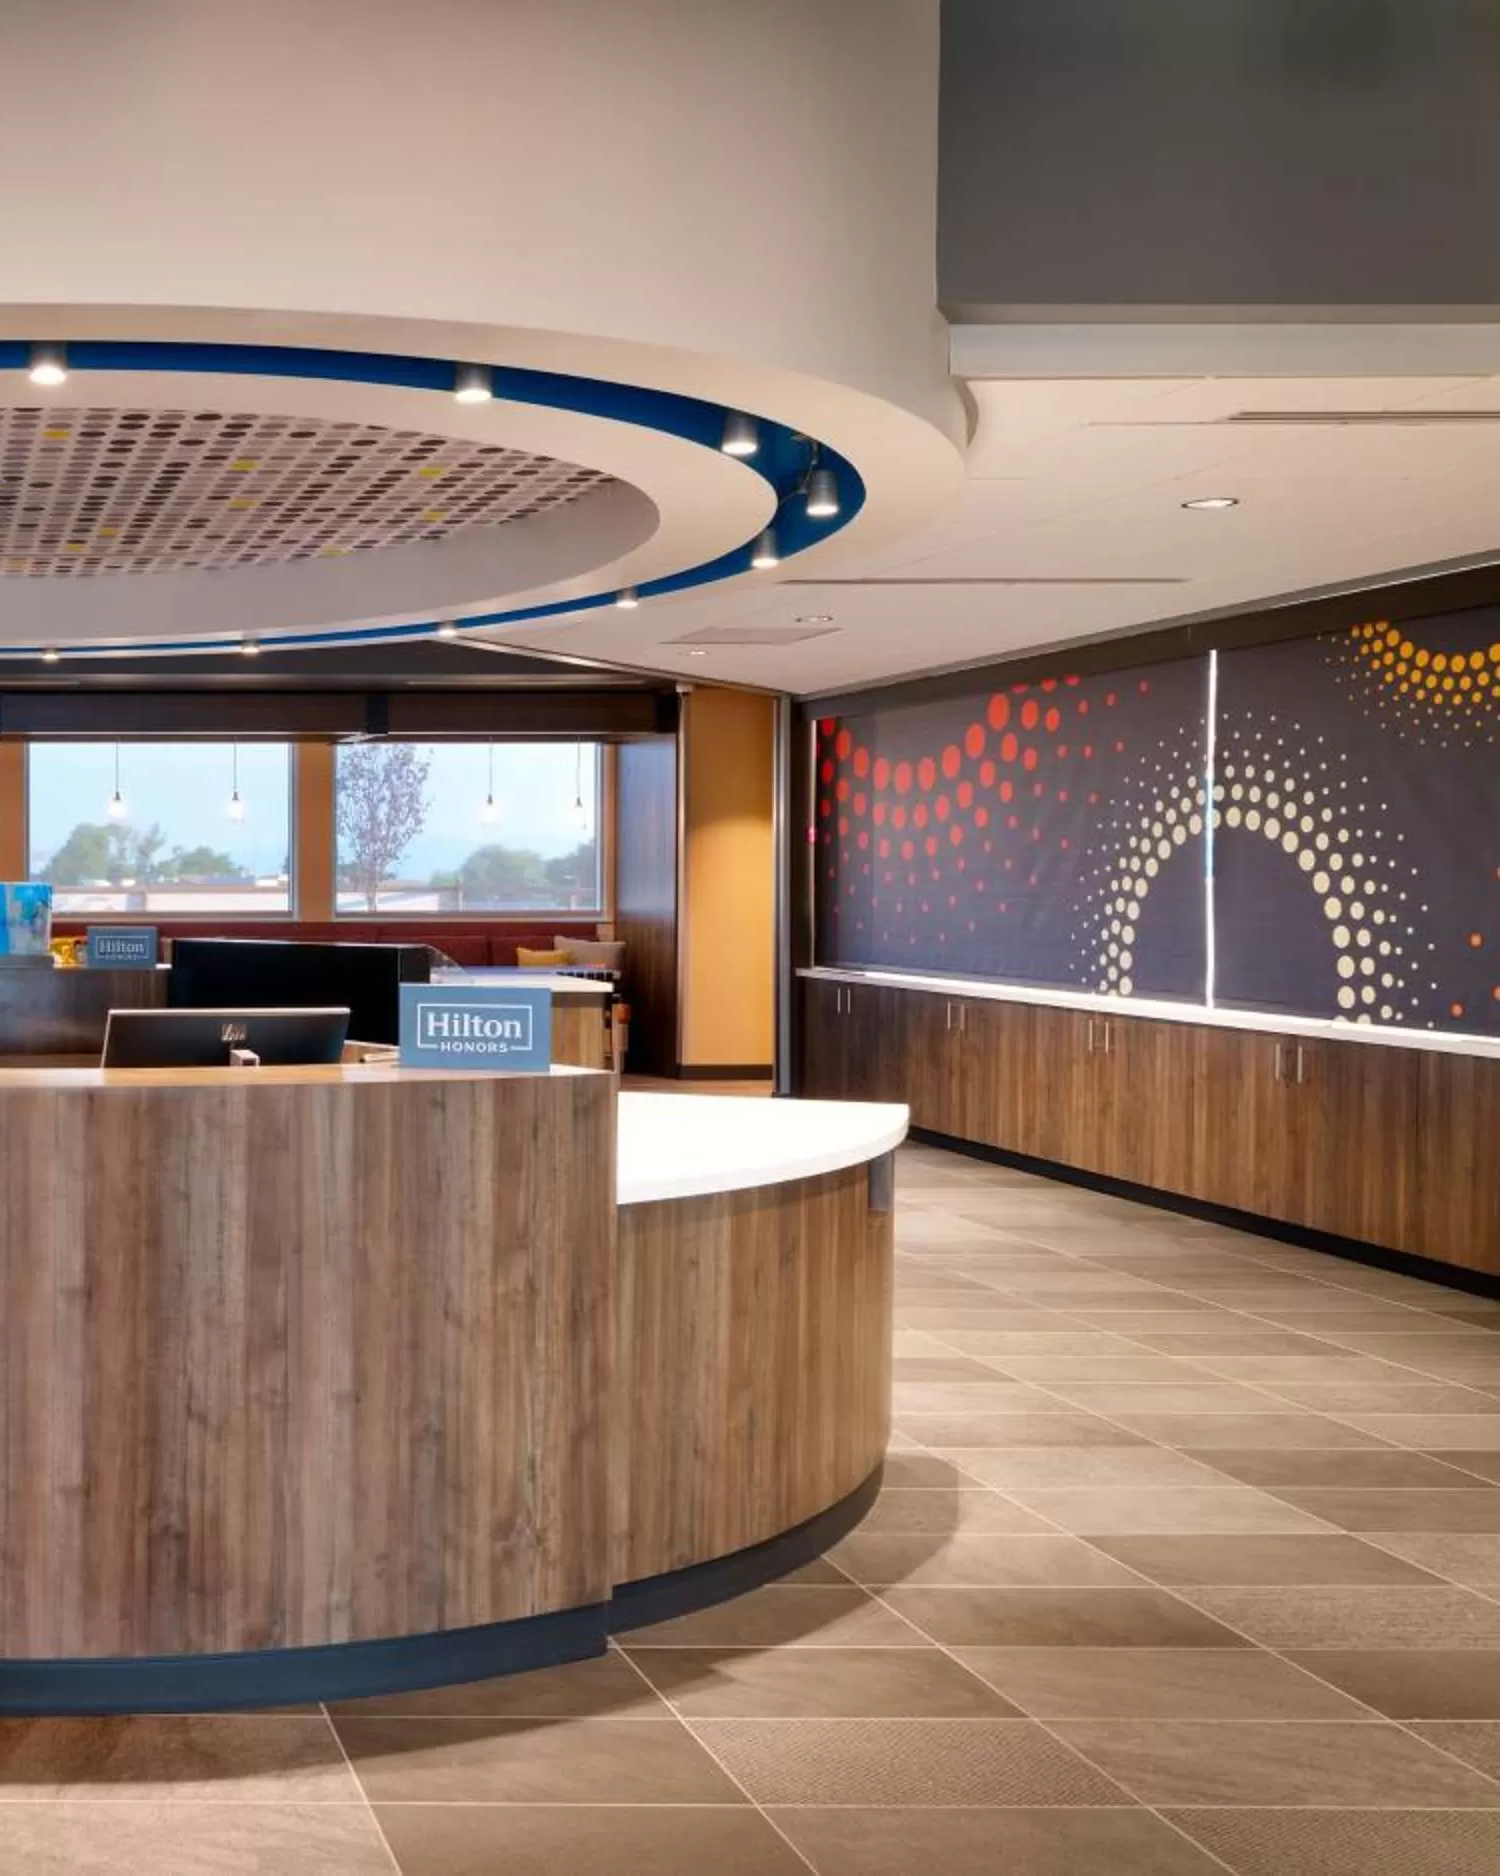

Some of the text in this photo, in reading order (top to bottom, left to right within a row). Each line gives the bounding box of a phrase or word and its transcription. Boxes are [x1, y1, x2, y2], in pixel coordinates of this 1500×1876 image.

[99, 939, 145, 953] Hilton
[427, 1011, 522, 1038] Hilton
[440, 1041, 509, 1053] HONORS
